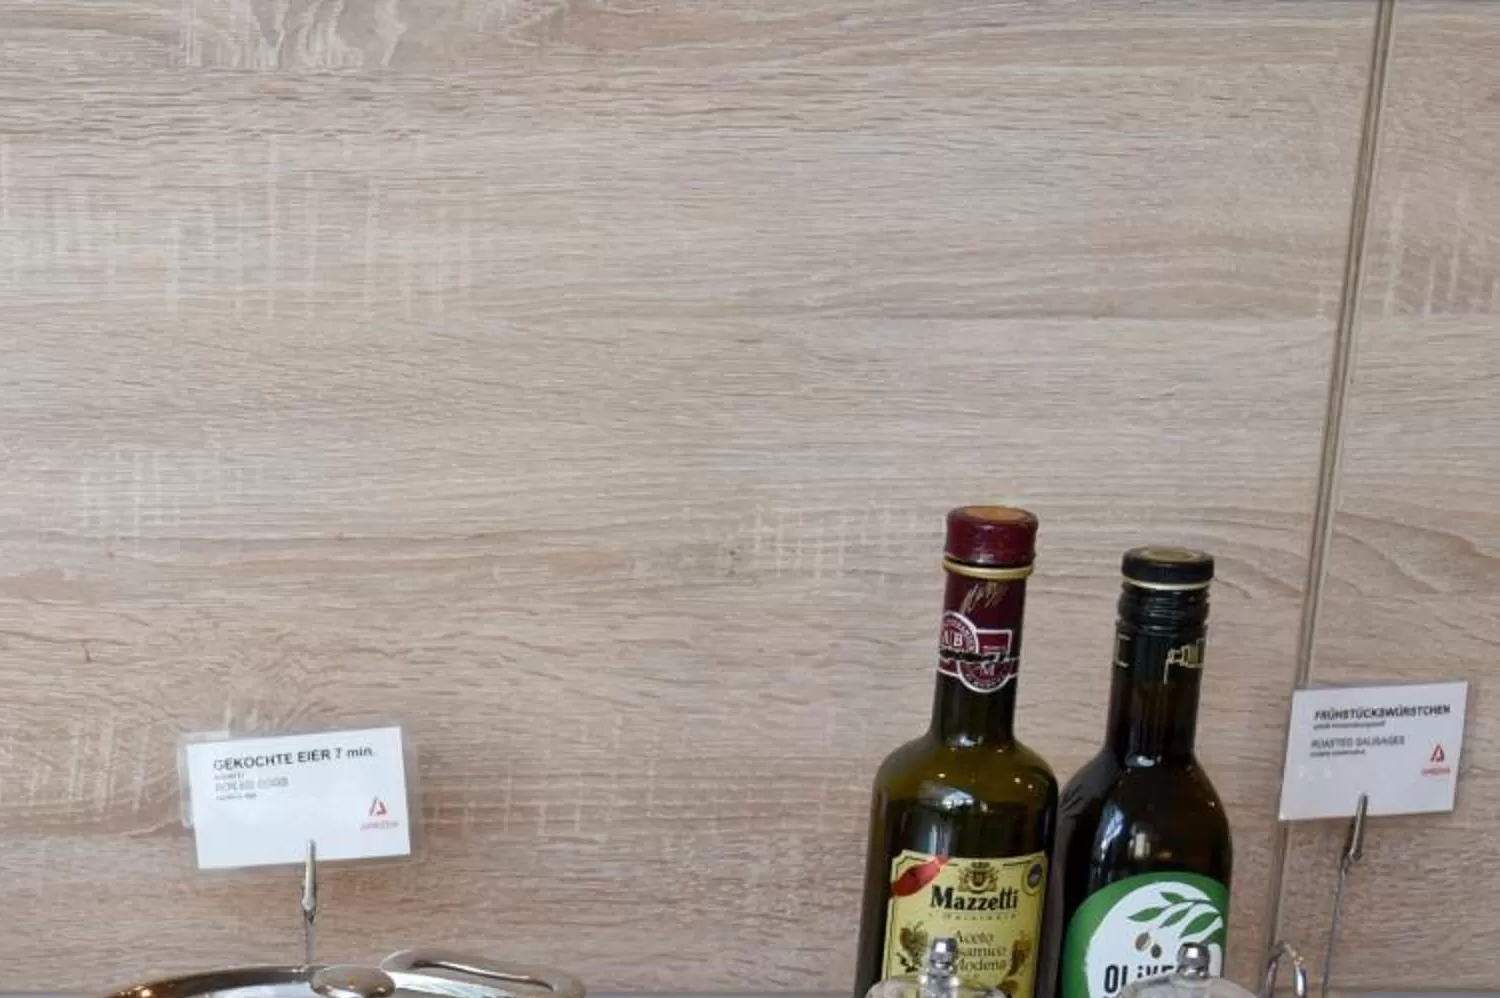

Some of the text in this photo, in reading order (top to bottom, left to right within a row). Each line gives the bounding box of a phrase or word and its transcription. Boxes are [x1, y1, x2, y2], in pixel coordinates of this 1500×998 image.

[213, 752, 293, 770] GEKOCHTE
[297, 750, 332, 762] EIER
[334, 748, 343, 759] 7
[930, 885, 1019, 910] Mazzetti
